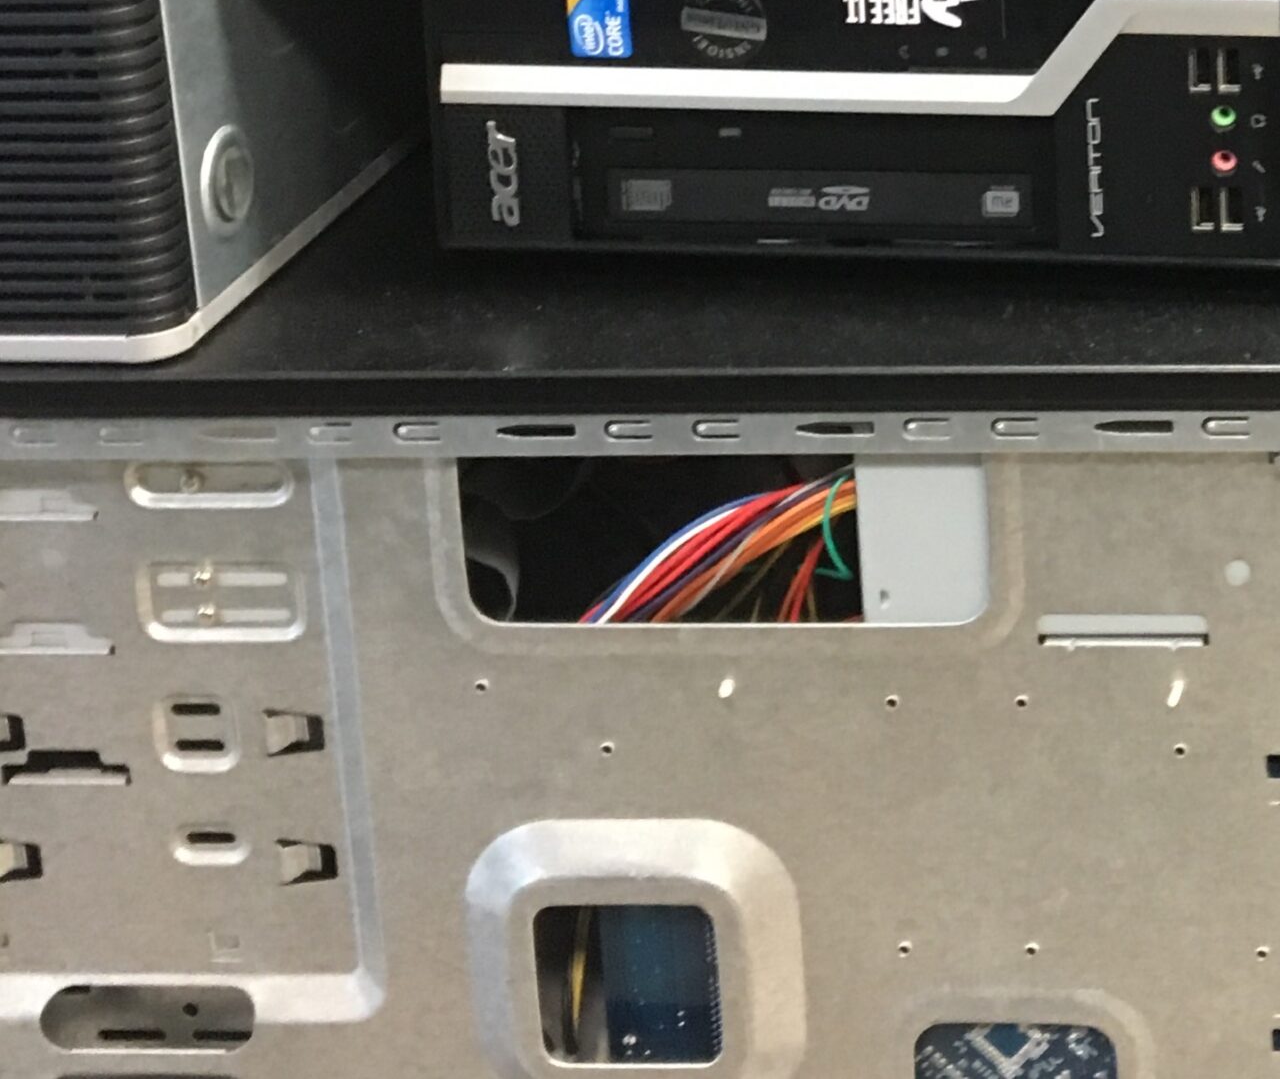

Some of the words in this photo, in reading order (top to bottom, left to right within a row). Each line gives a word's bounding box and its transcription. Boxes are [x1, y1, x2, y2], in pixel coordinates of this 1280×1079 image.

[605, 15, 624, 56] CORE
[486, 120, 520, 227] acer
[818, 194, 870, 212] DVD
